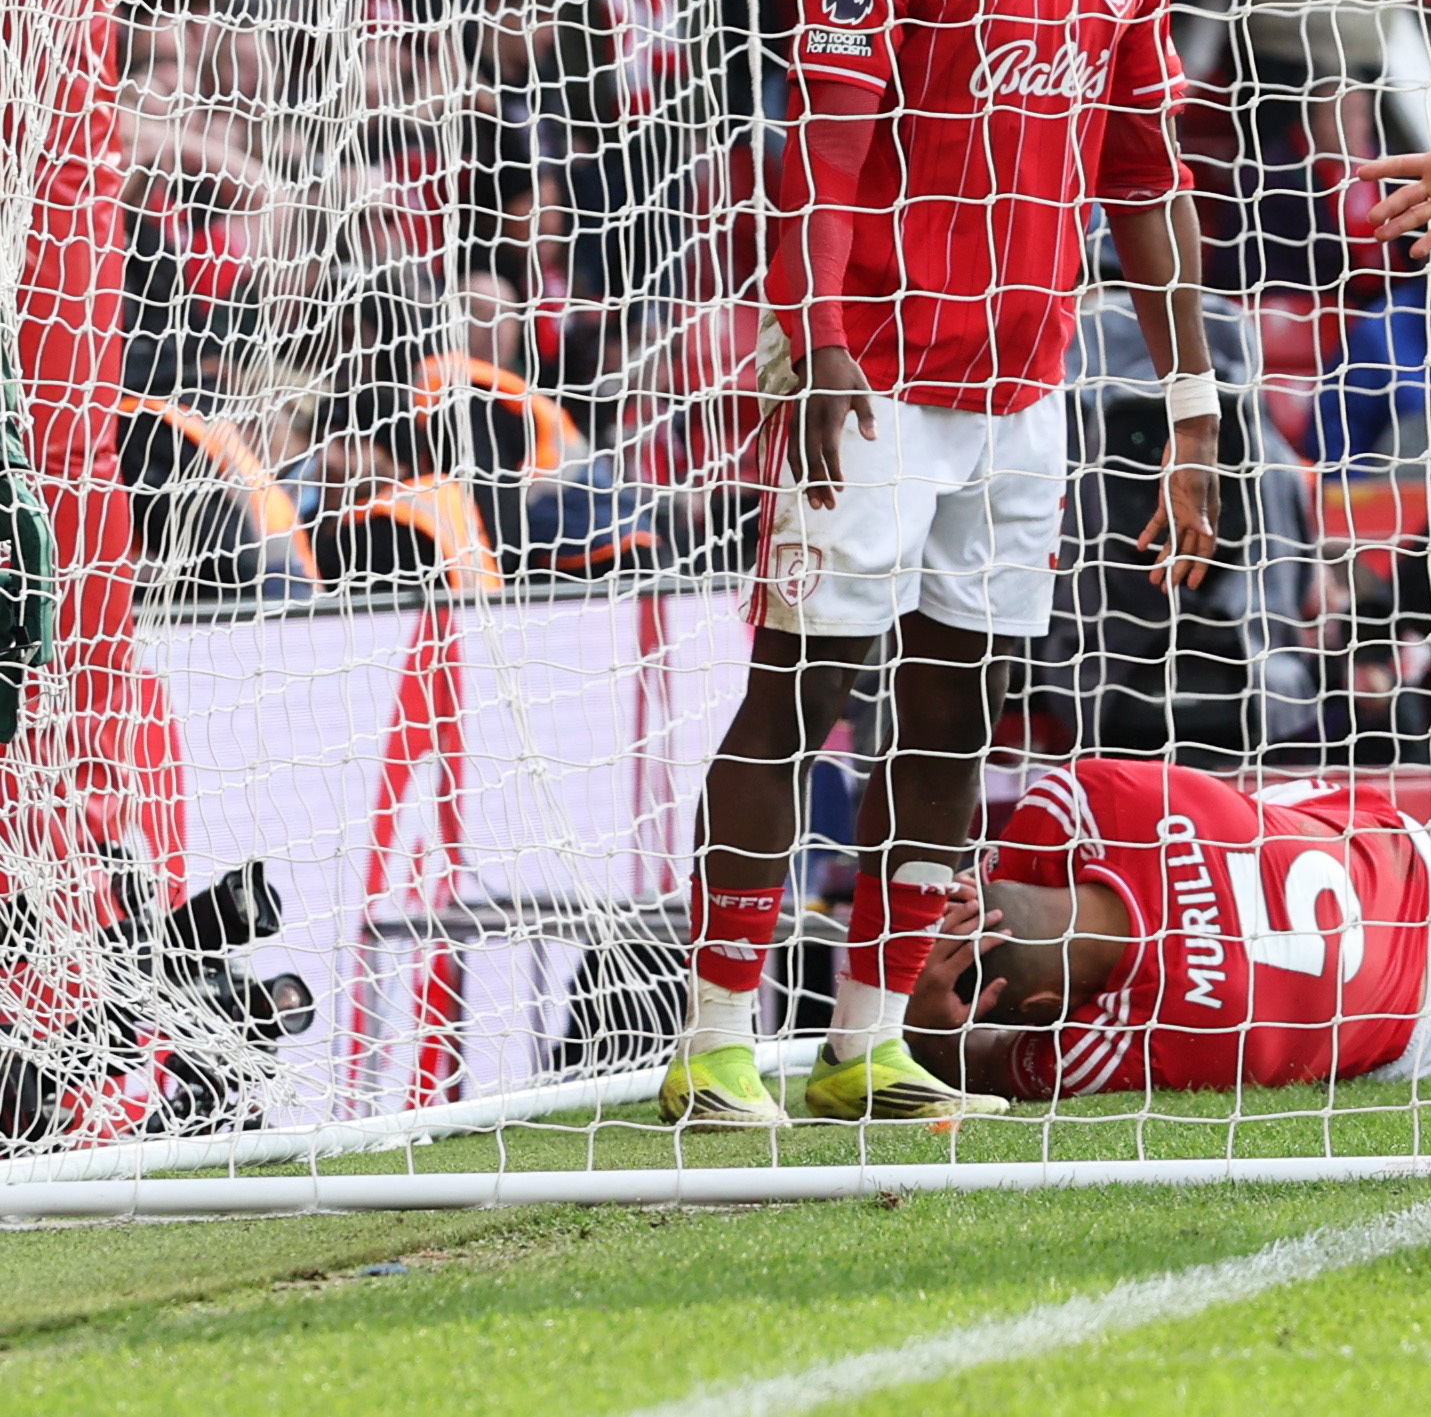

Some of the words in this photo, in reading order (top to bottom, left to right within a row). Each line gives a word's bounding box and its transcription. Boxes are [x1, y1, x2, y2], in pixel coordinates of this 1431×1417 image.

[808, 30, 827, 43] No
[829, 33, 867, 45] room
[826, 44, 872, 56] racism
[969, 39, 1110, 99] Bally's
[1156, 815, 1226, 1009] MURILLO
[1225, 849, 1365, 984] 5
